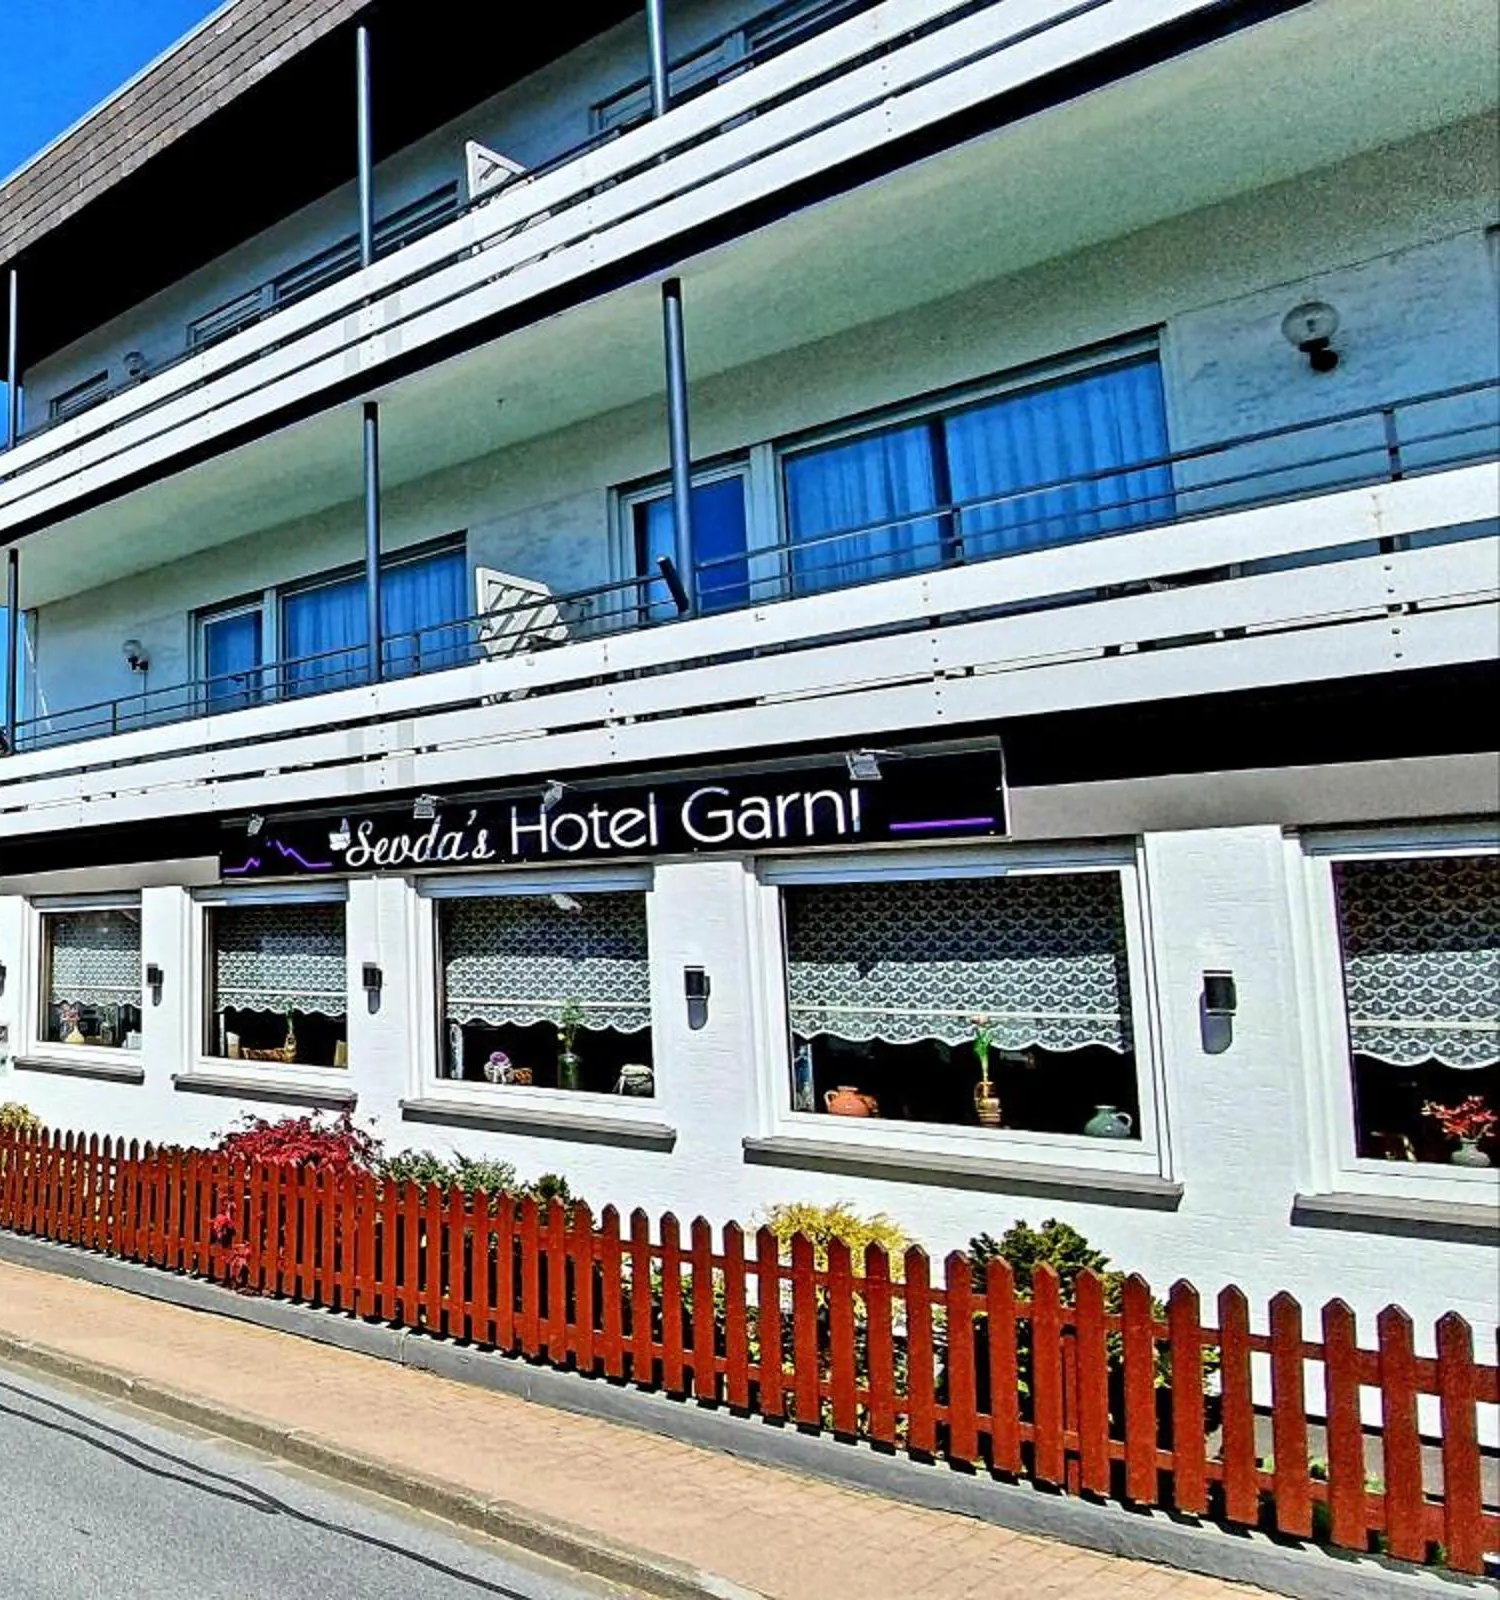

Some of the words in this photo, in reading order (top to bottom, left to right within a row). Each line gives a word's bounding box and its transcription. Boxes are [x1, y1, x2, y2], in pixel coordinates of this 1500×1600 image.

[345, 809, 496, 867] Sevda's
[510, 791, 659, 855] Hotel
[680, 786, 861, 844] Garni
